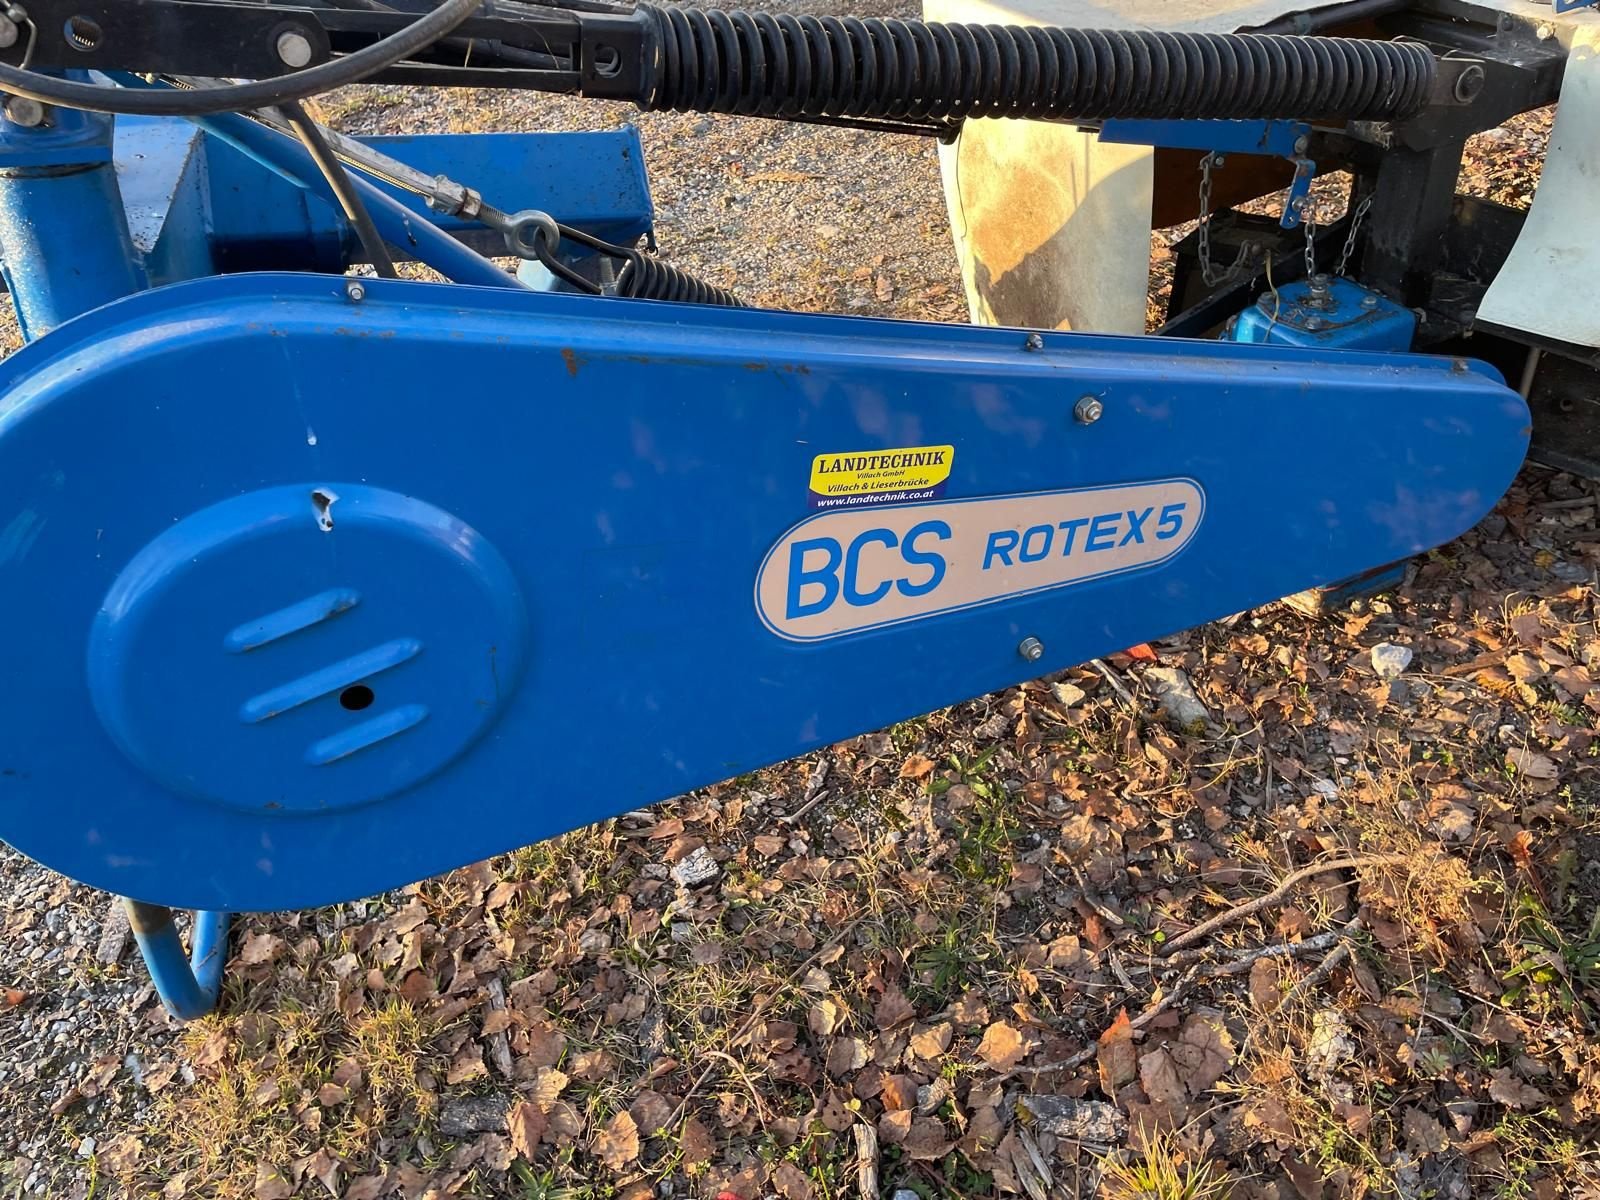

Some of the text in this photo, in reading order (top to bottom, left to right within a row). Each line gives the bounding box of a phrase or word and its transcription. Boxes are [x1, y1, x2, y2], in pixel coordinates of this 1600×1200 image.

[818, 451, 945, 474] LANDTECHNIK
[882, 469, 905, 478] GmbH
[827, 478, 929, 492] Villach & Lieserbrücke
[817, 490, 934, 507] www.landtechnik.co.at
[785, 519, 952, 620] BCS
[982, 506, 1155, 570] ROTEX
